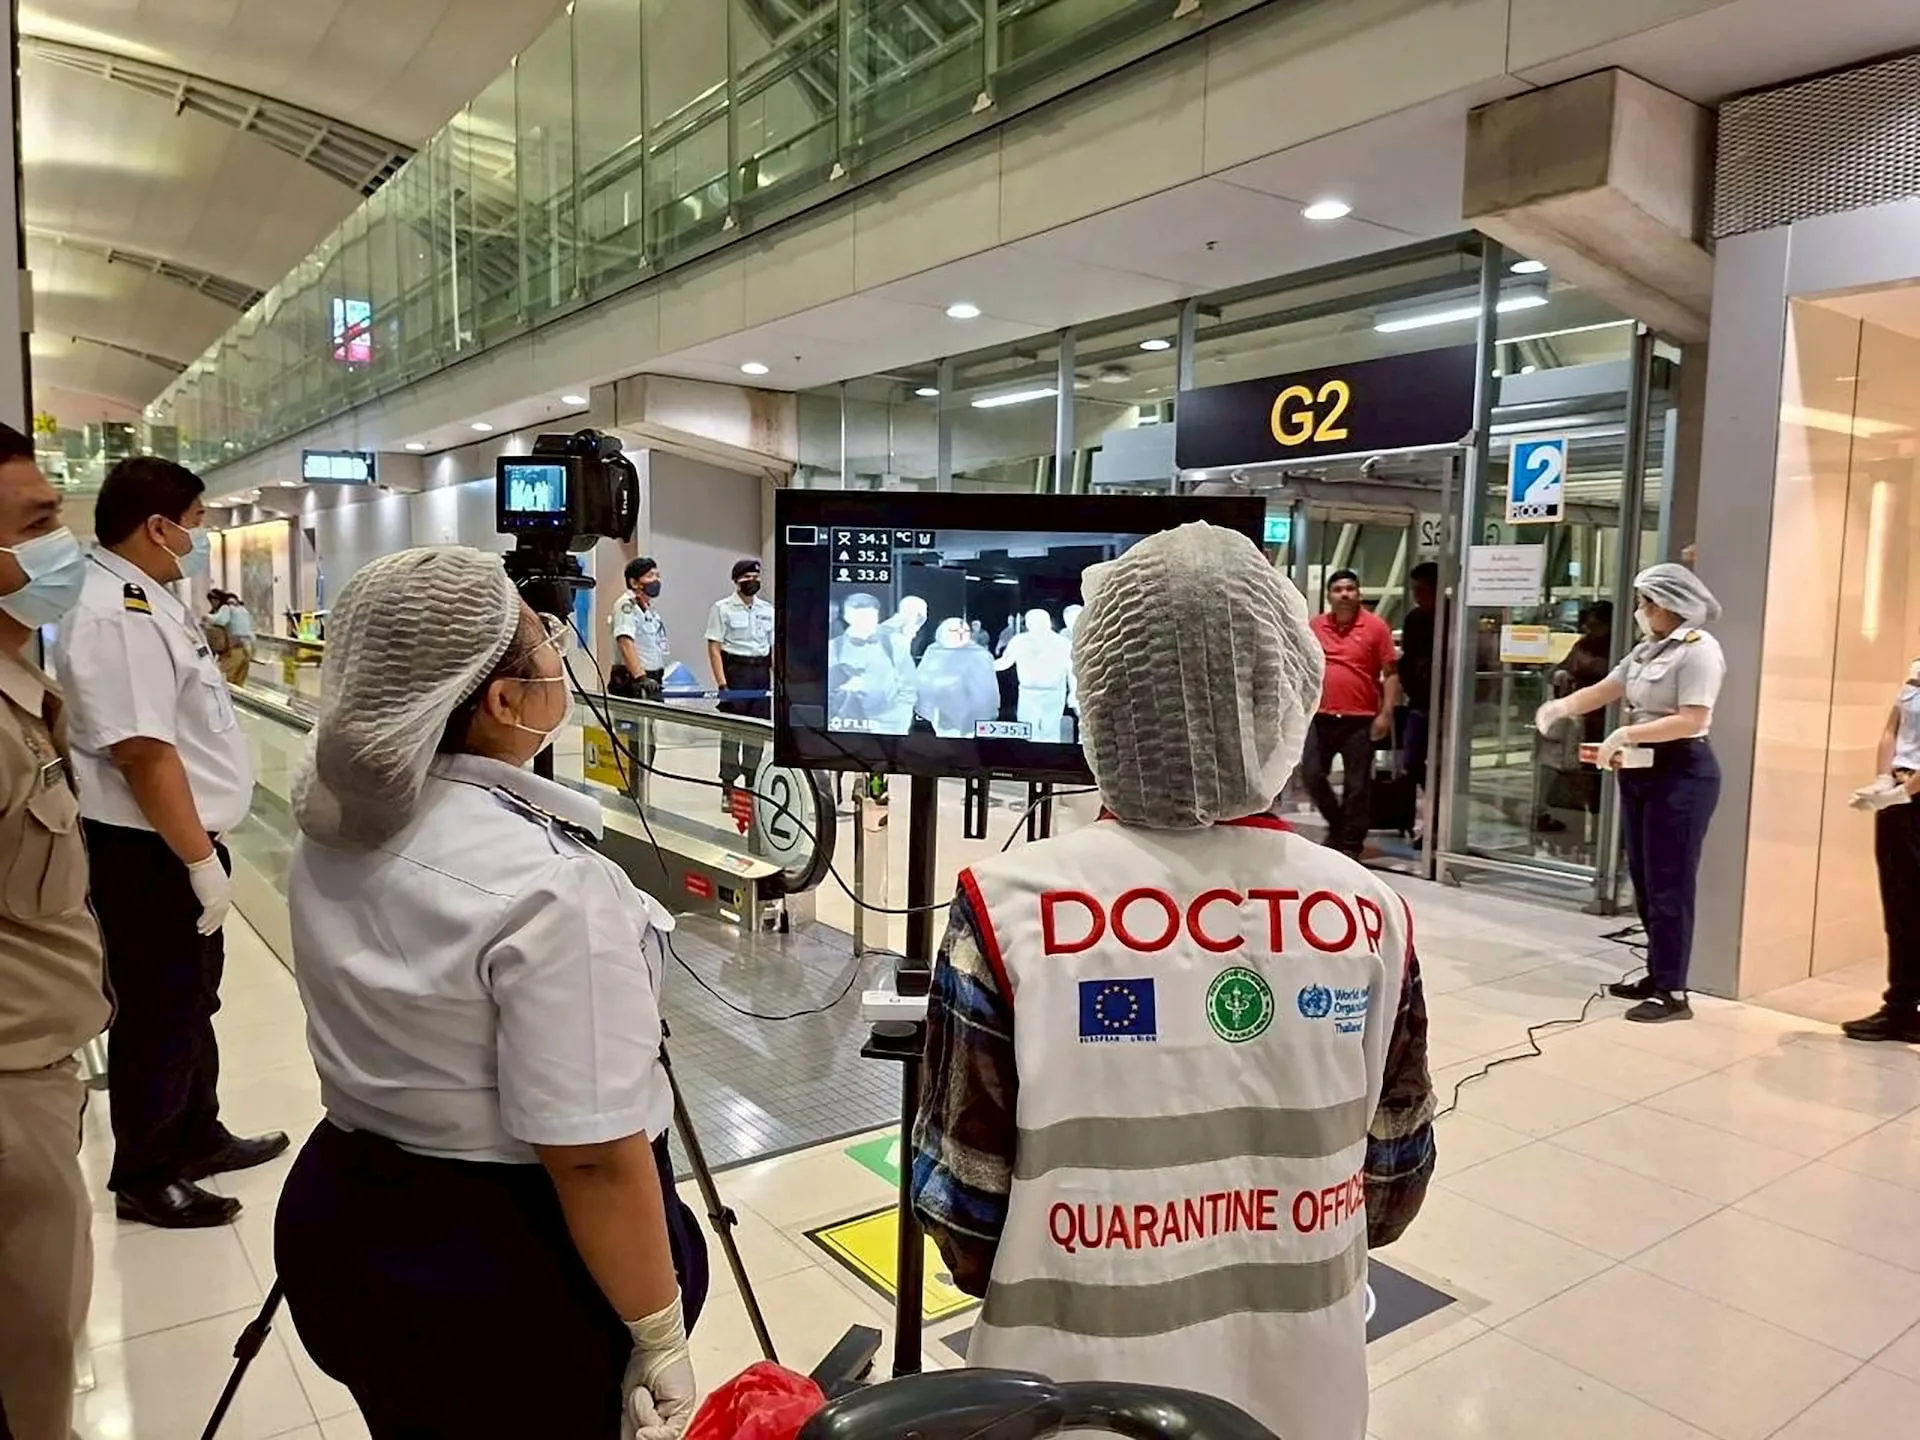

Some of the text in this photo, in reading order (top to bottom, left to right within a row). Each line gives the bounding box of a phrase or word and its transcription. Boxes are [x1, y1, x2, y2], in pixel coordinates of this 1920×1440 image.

[1271, 380, 1350, 446] G2
[1524, 445, 1562, 503] 2
[857, 550, 888, 563] 35.1
[858, 532, 888, 545] 34.1
[896, 532, 911, 543] °C
[857, 569, 889, 582] 33.8
[770, 774, 791, 841] 2
[1040, 887, 1383, 956] DOCTOR
[1049, 1188, 1279, 1254] QUARANTINE
